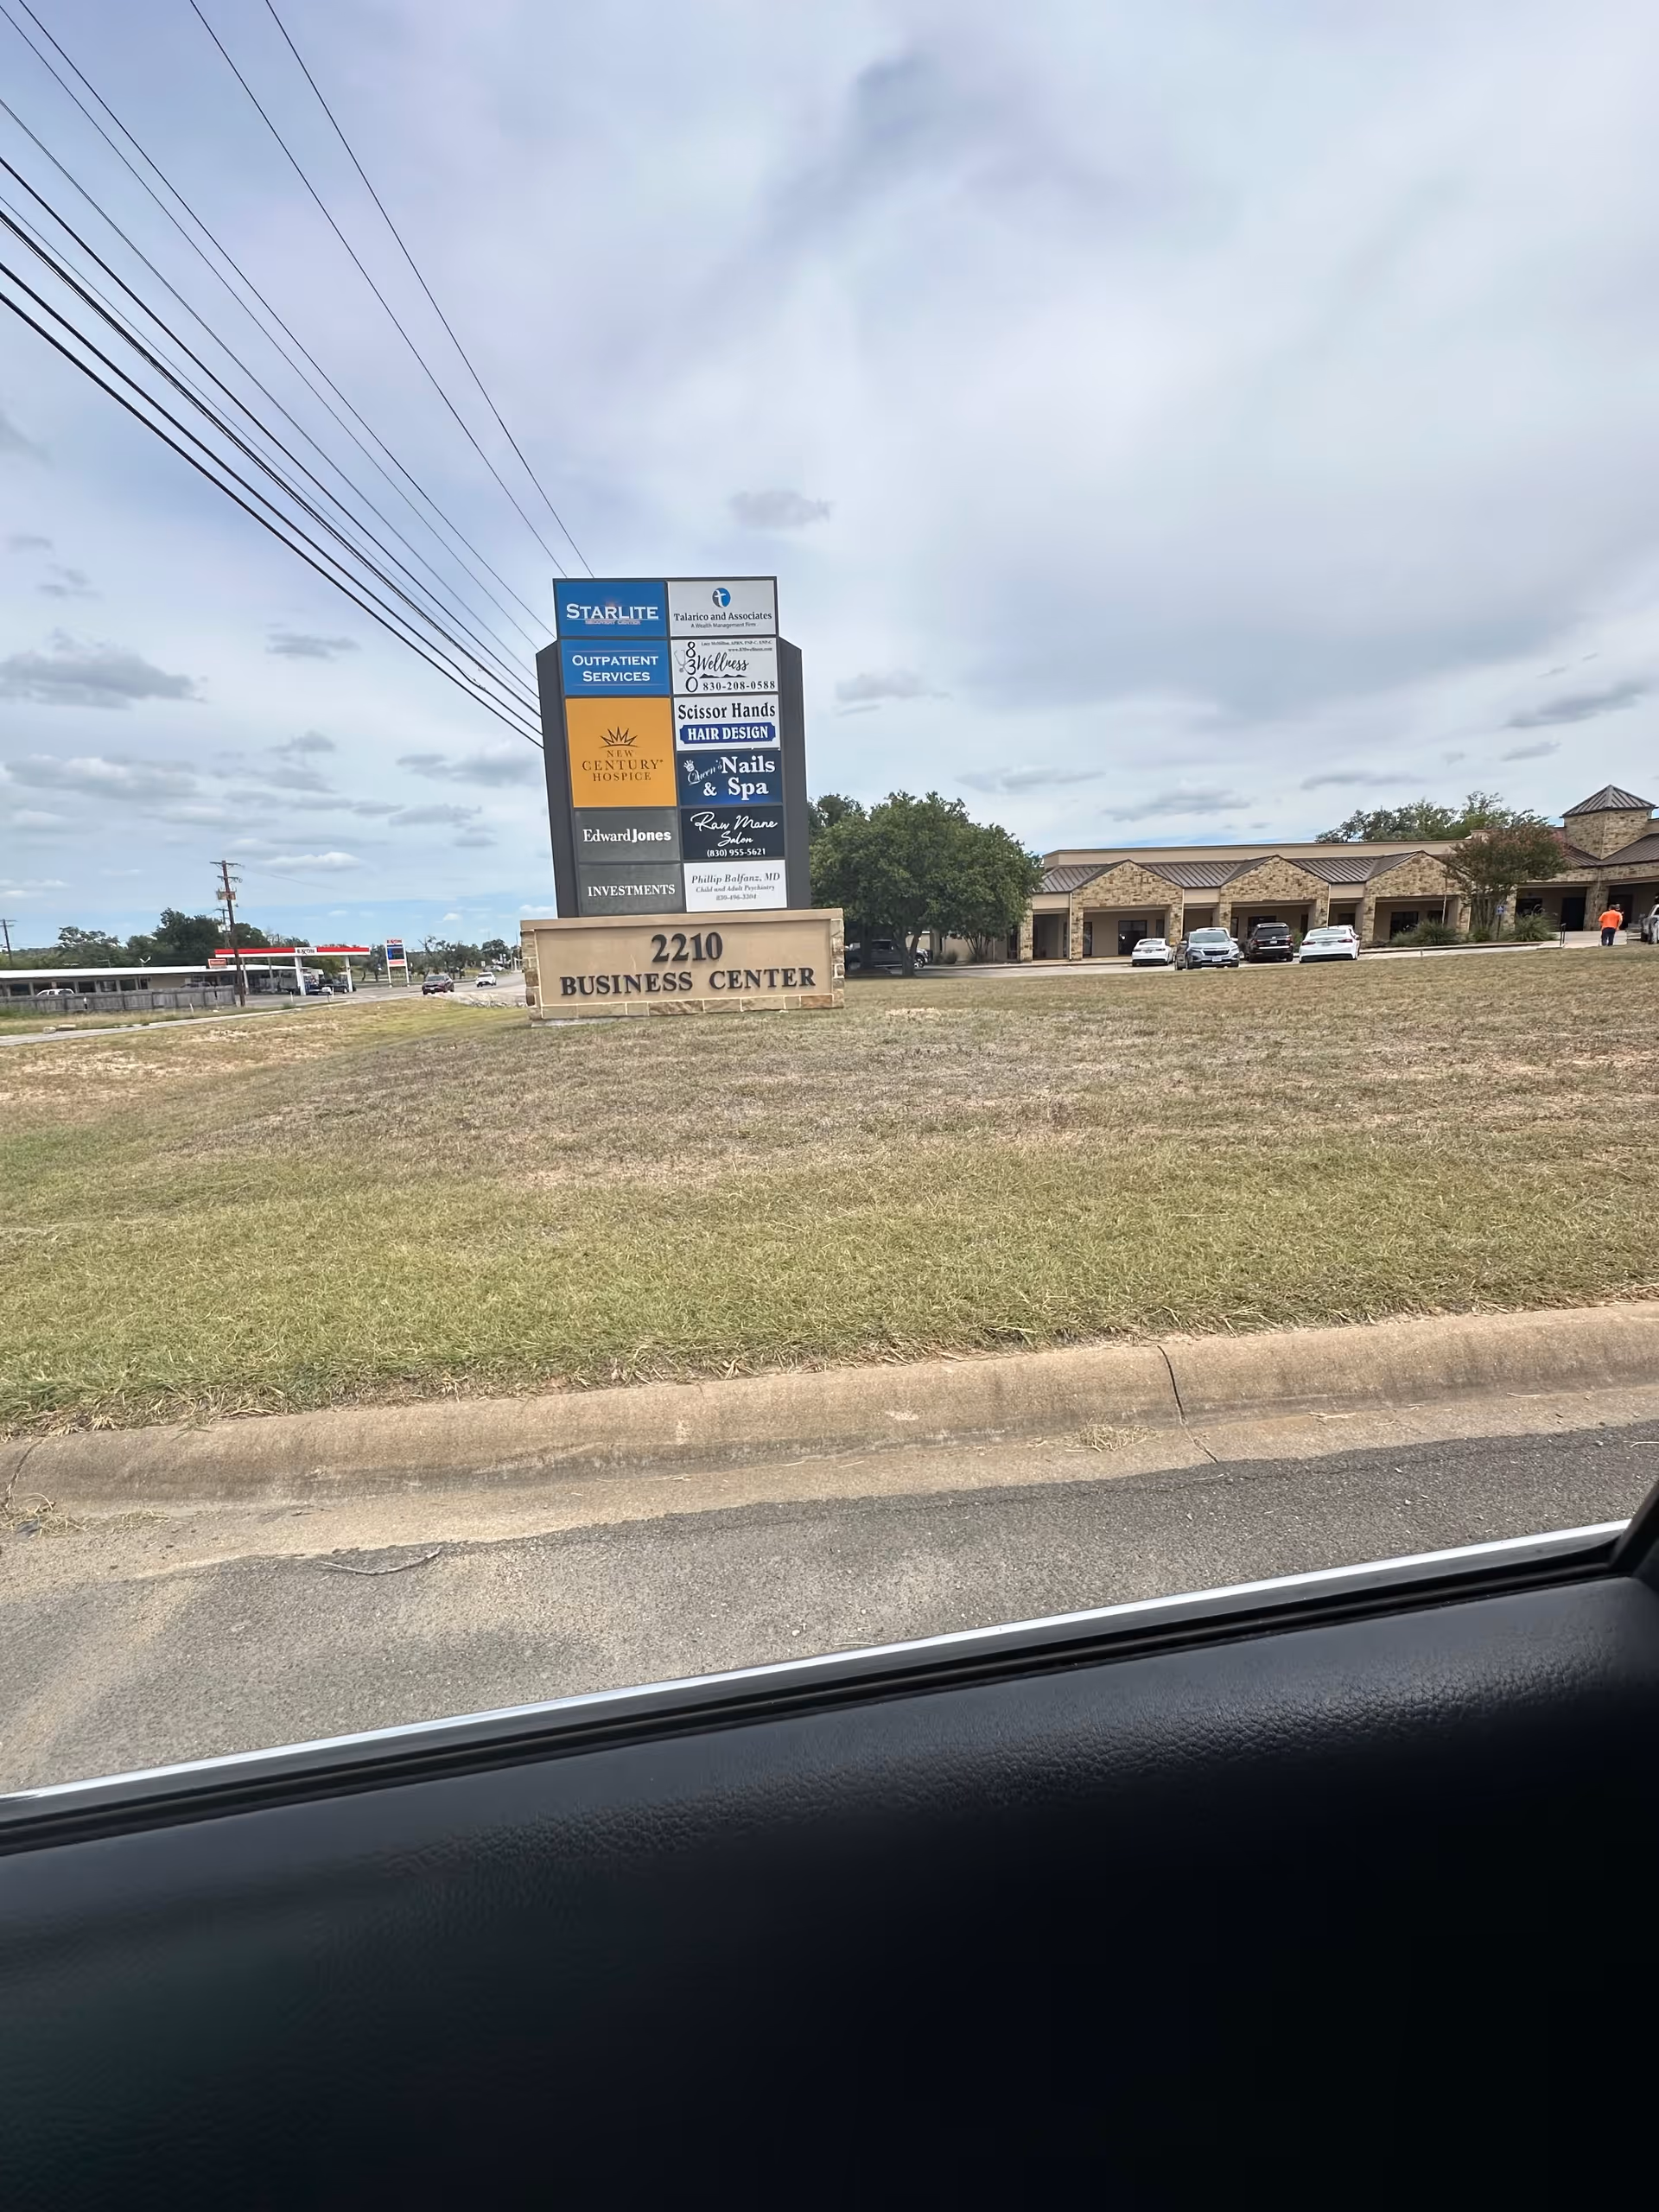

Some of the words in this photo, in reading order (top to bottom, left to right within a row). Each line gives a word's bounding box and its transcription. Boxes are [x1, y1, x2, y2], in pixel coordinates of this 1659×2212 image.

[566, 604, 659, 620] STARLITE
[674, 613, 709, 621] Talarico
[728, 612, 772, 620] Associates
[572, 655, 658, 666] OUTPATIENT
[696, 652, 749, 672] Wellness
[582, 671, 650, 682] SERVICES
[702, 680, 775, 690] 830-208-0588
[678, 704, 728, 720] Scissor
[731, 702, 776, 718] Hands
[687, 728, 719, 741] HAIR
[722, 726, 768, 740] DESIGN
[582, 760, 659, 771] CENTURY
[687, 760, 722, 785] Queen's
[721, 755, 776, 774] Nails
[593, 772, 652, 782] HOSPICE
[703, 782, 717, 797] &
[728, 777, 769, 801] Spa
[690, 811, 729, 831] Raw
[734, 815, 778, 830] Mane
[582, 828, 631, 842] Edward
[632, 828, 672, 842] Jones
[717, 830, 753, 847] Salon
[707, 849, 728, 858] (830)
[728, 848, 766, 856] 955-5621
[691, 874, 722, 885] Phillip
[724, 874, 762, 883] Balfanz,
[764, 873, 780, 881] MD
[588, 884, 676, 897] INVESTMENTS
[651, 931, 724, 963] 2210
[560, 971, 693, 996] BUSINESS
[709, 967, 817, 990] CENTER
